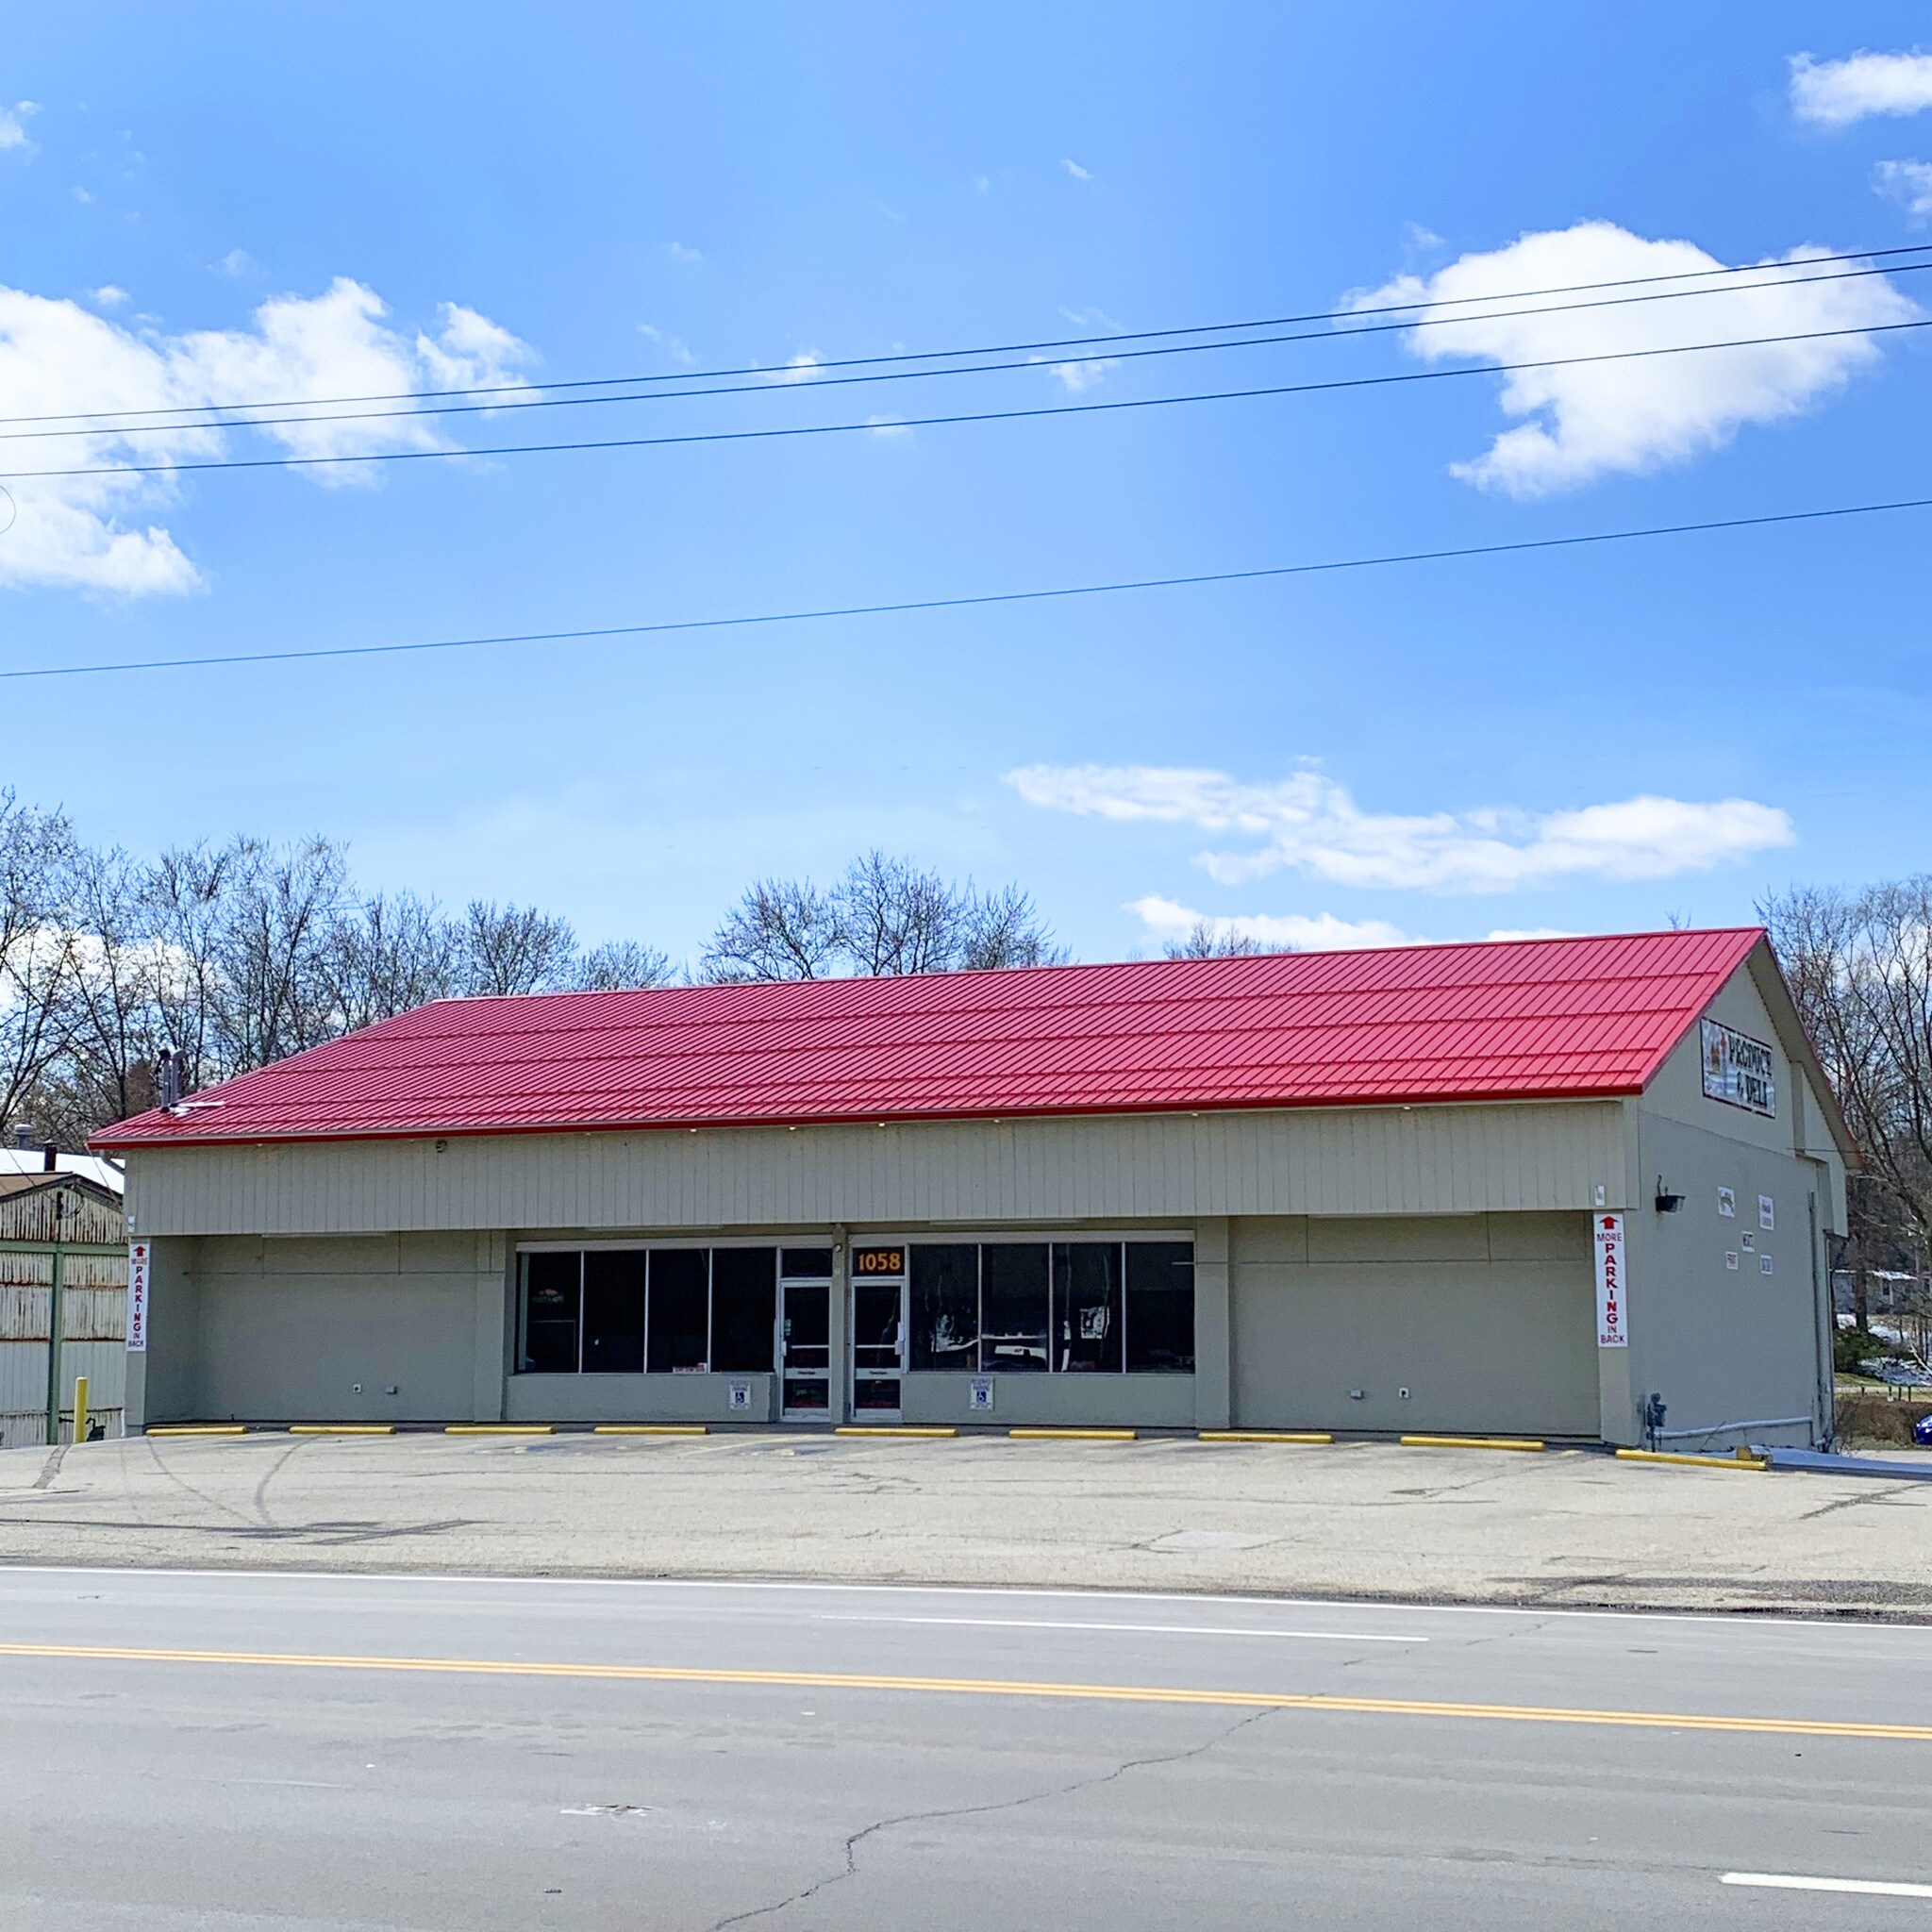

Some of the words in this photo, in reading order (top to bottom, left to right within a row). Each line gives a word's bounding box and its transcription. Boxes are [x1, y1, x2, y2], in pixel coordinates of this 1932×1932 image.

[1728, 1034, 1773, 1077] PRODUCE
[1745, 1074, 1769, 1109] DELI
[1597, 1233, 1622, 1241] MORE
[858, 1253, 901, 1271] 1058
[134, 1266, 143, 1332] PARKING
[1605, 1243, 1618, 1324] PARKING
[1600, 1335, 1624, 1343] BACK
